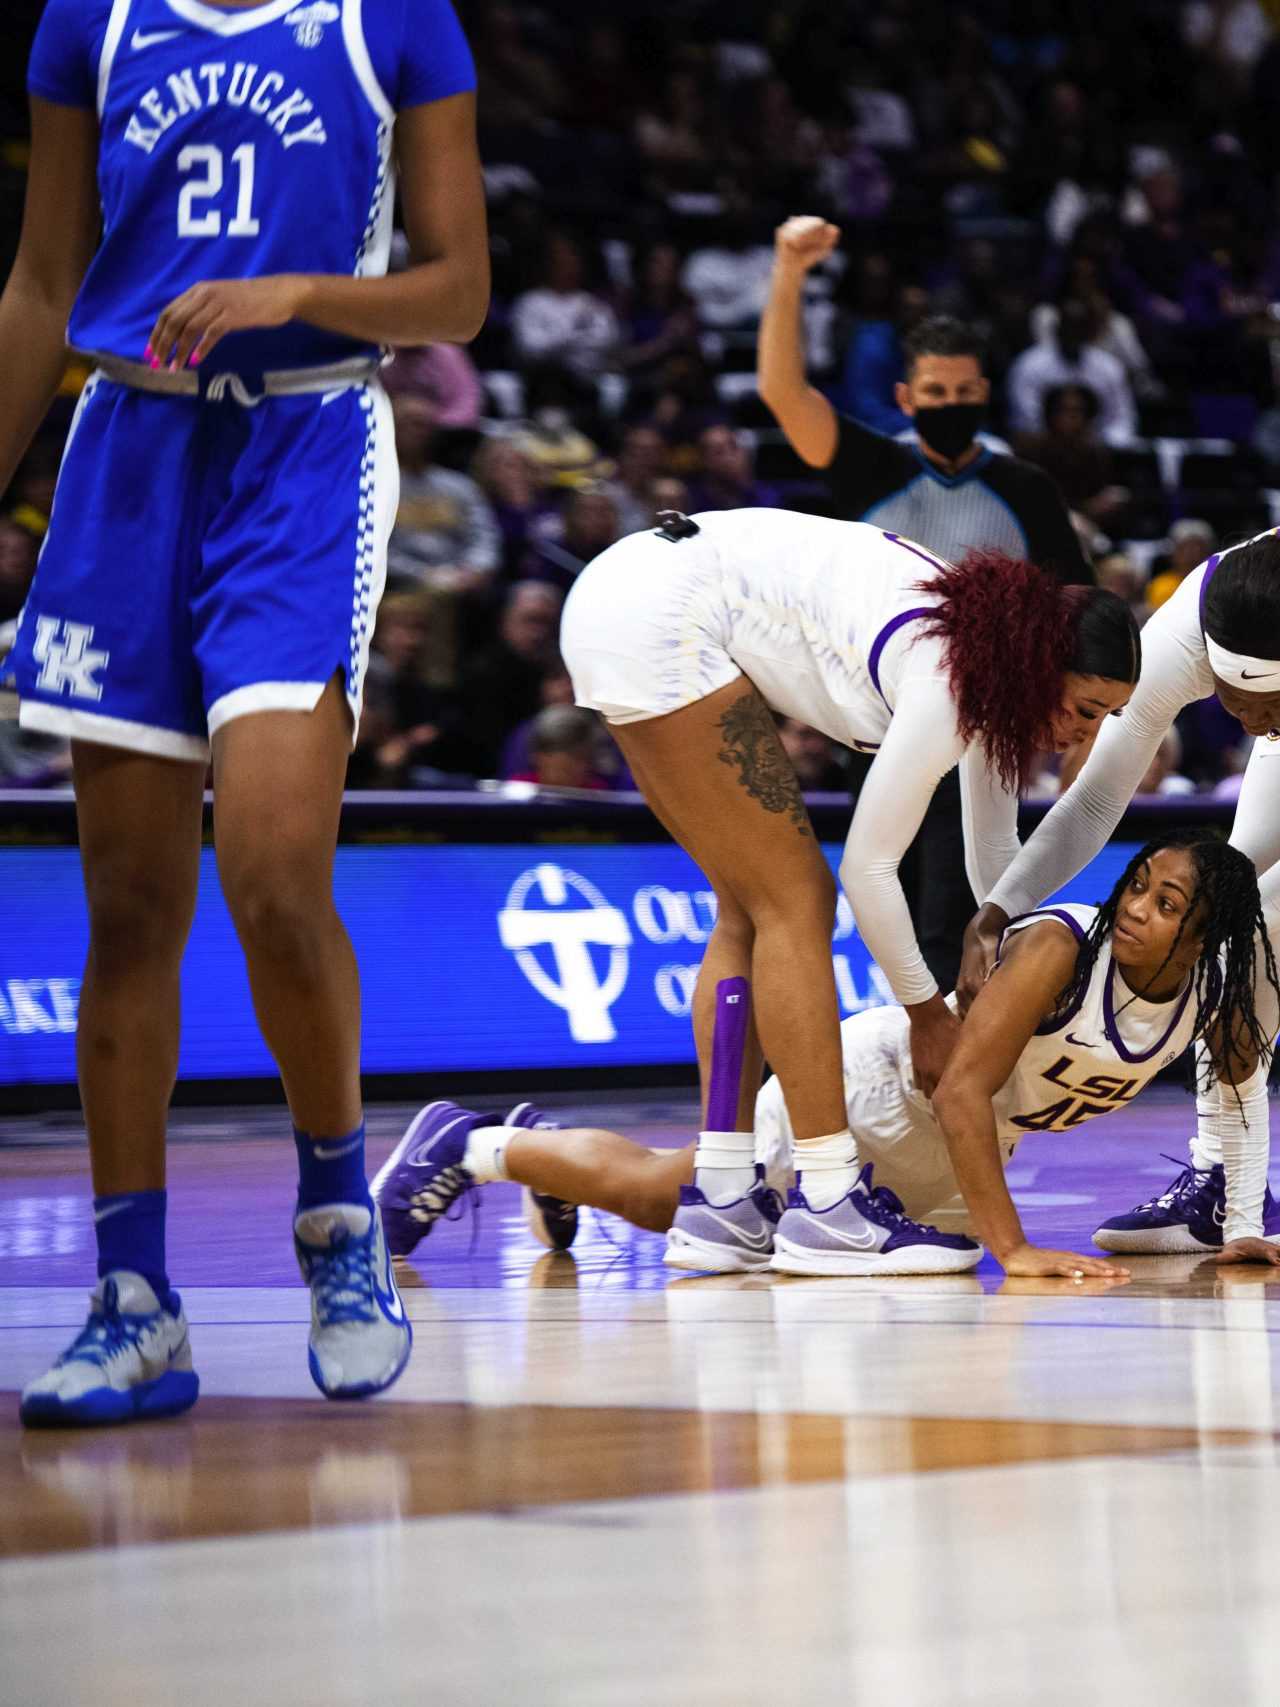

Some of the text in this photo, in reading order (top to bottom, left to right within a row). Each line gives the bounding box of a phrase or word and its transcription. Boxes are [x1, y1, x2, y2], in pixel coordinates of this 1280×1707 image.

[123, 61, 328, 154] KENTUCKY
[177, 142, 260, 238] 21
[33, 613, 110, 702] UK
